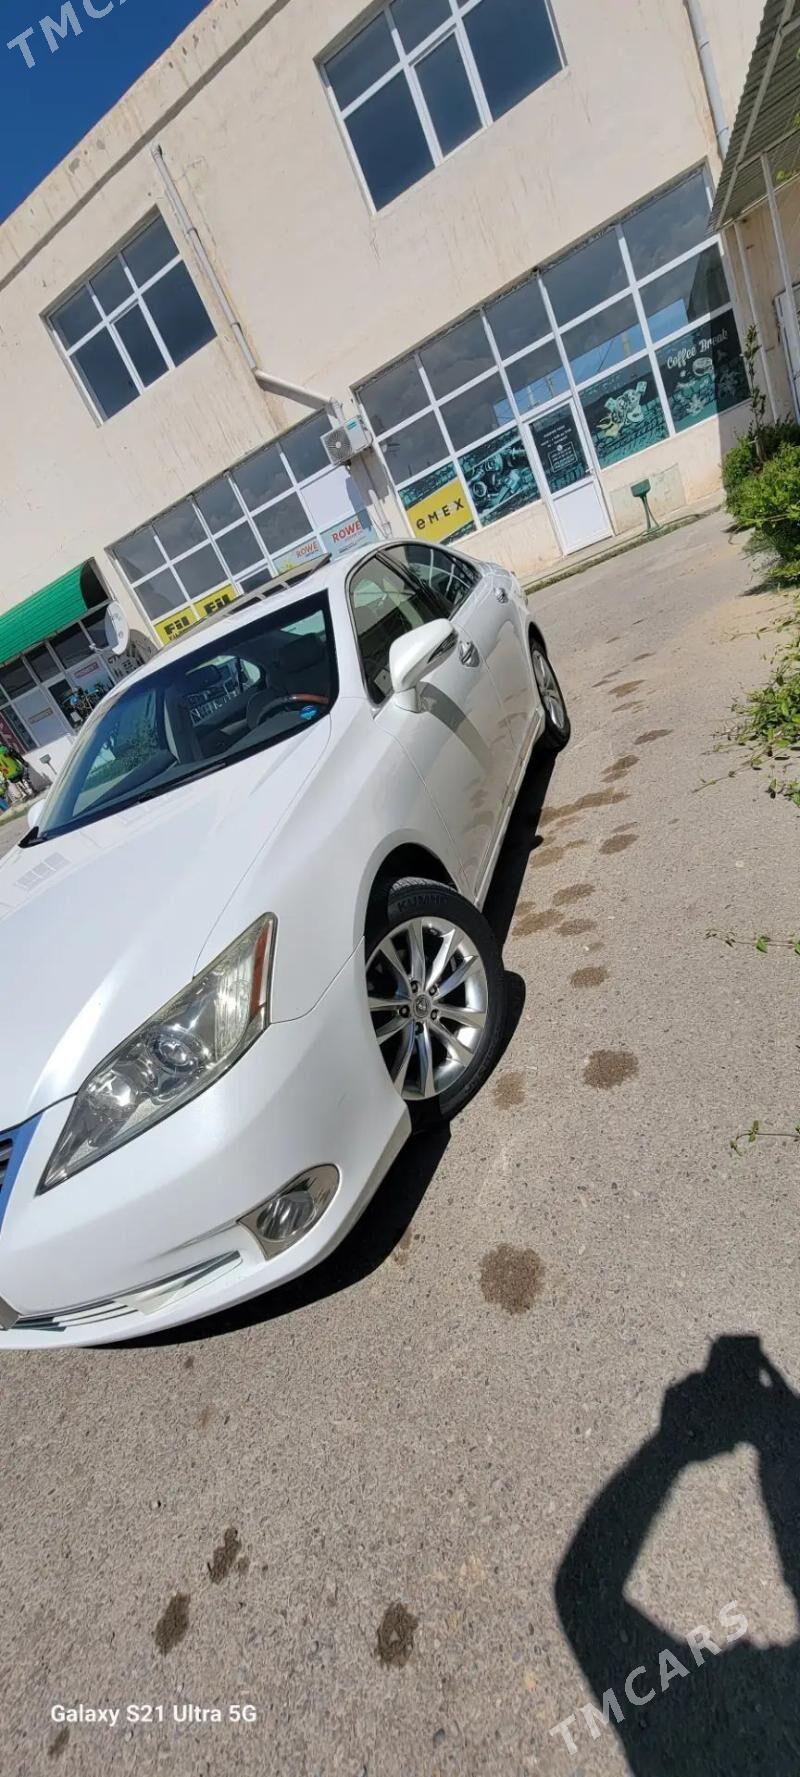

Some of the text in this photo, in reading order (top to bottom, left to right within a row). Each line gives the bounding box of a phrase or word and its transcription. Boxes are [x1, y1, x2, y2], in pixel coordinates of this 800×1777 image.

[667, 328, 729, 369] Coffee Break
[332, 520, 362, 543] ROWE
[296, 541, 319, 558] ROWE
